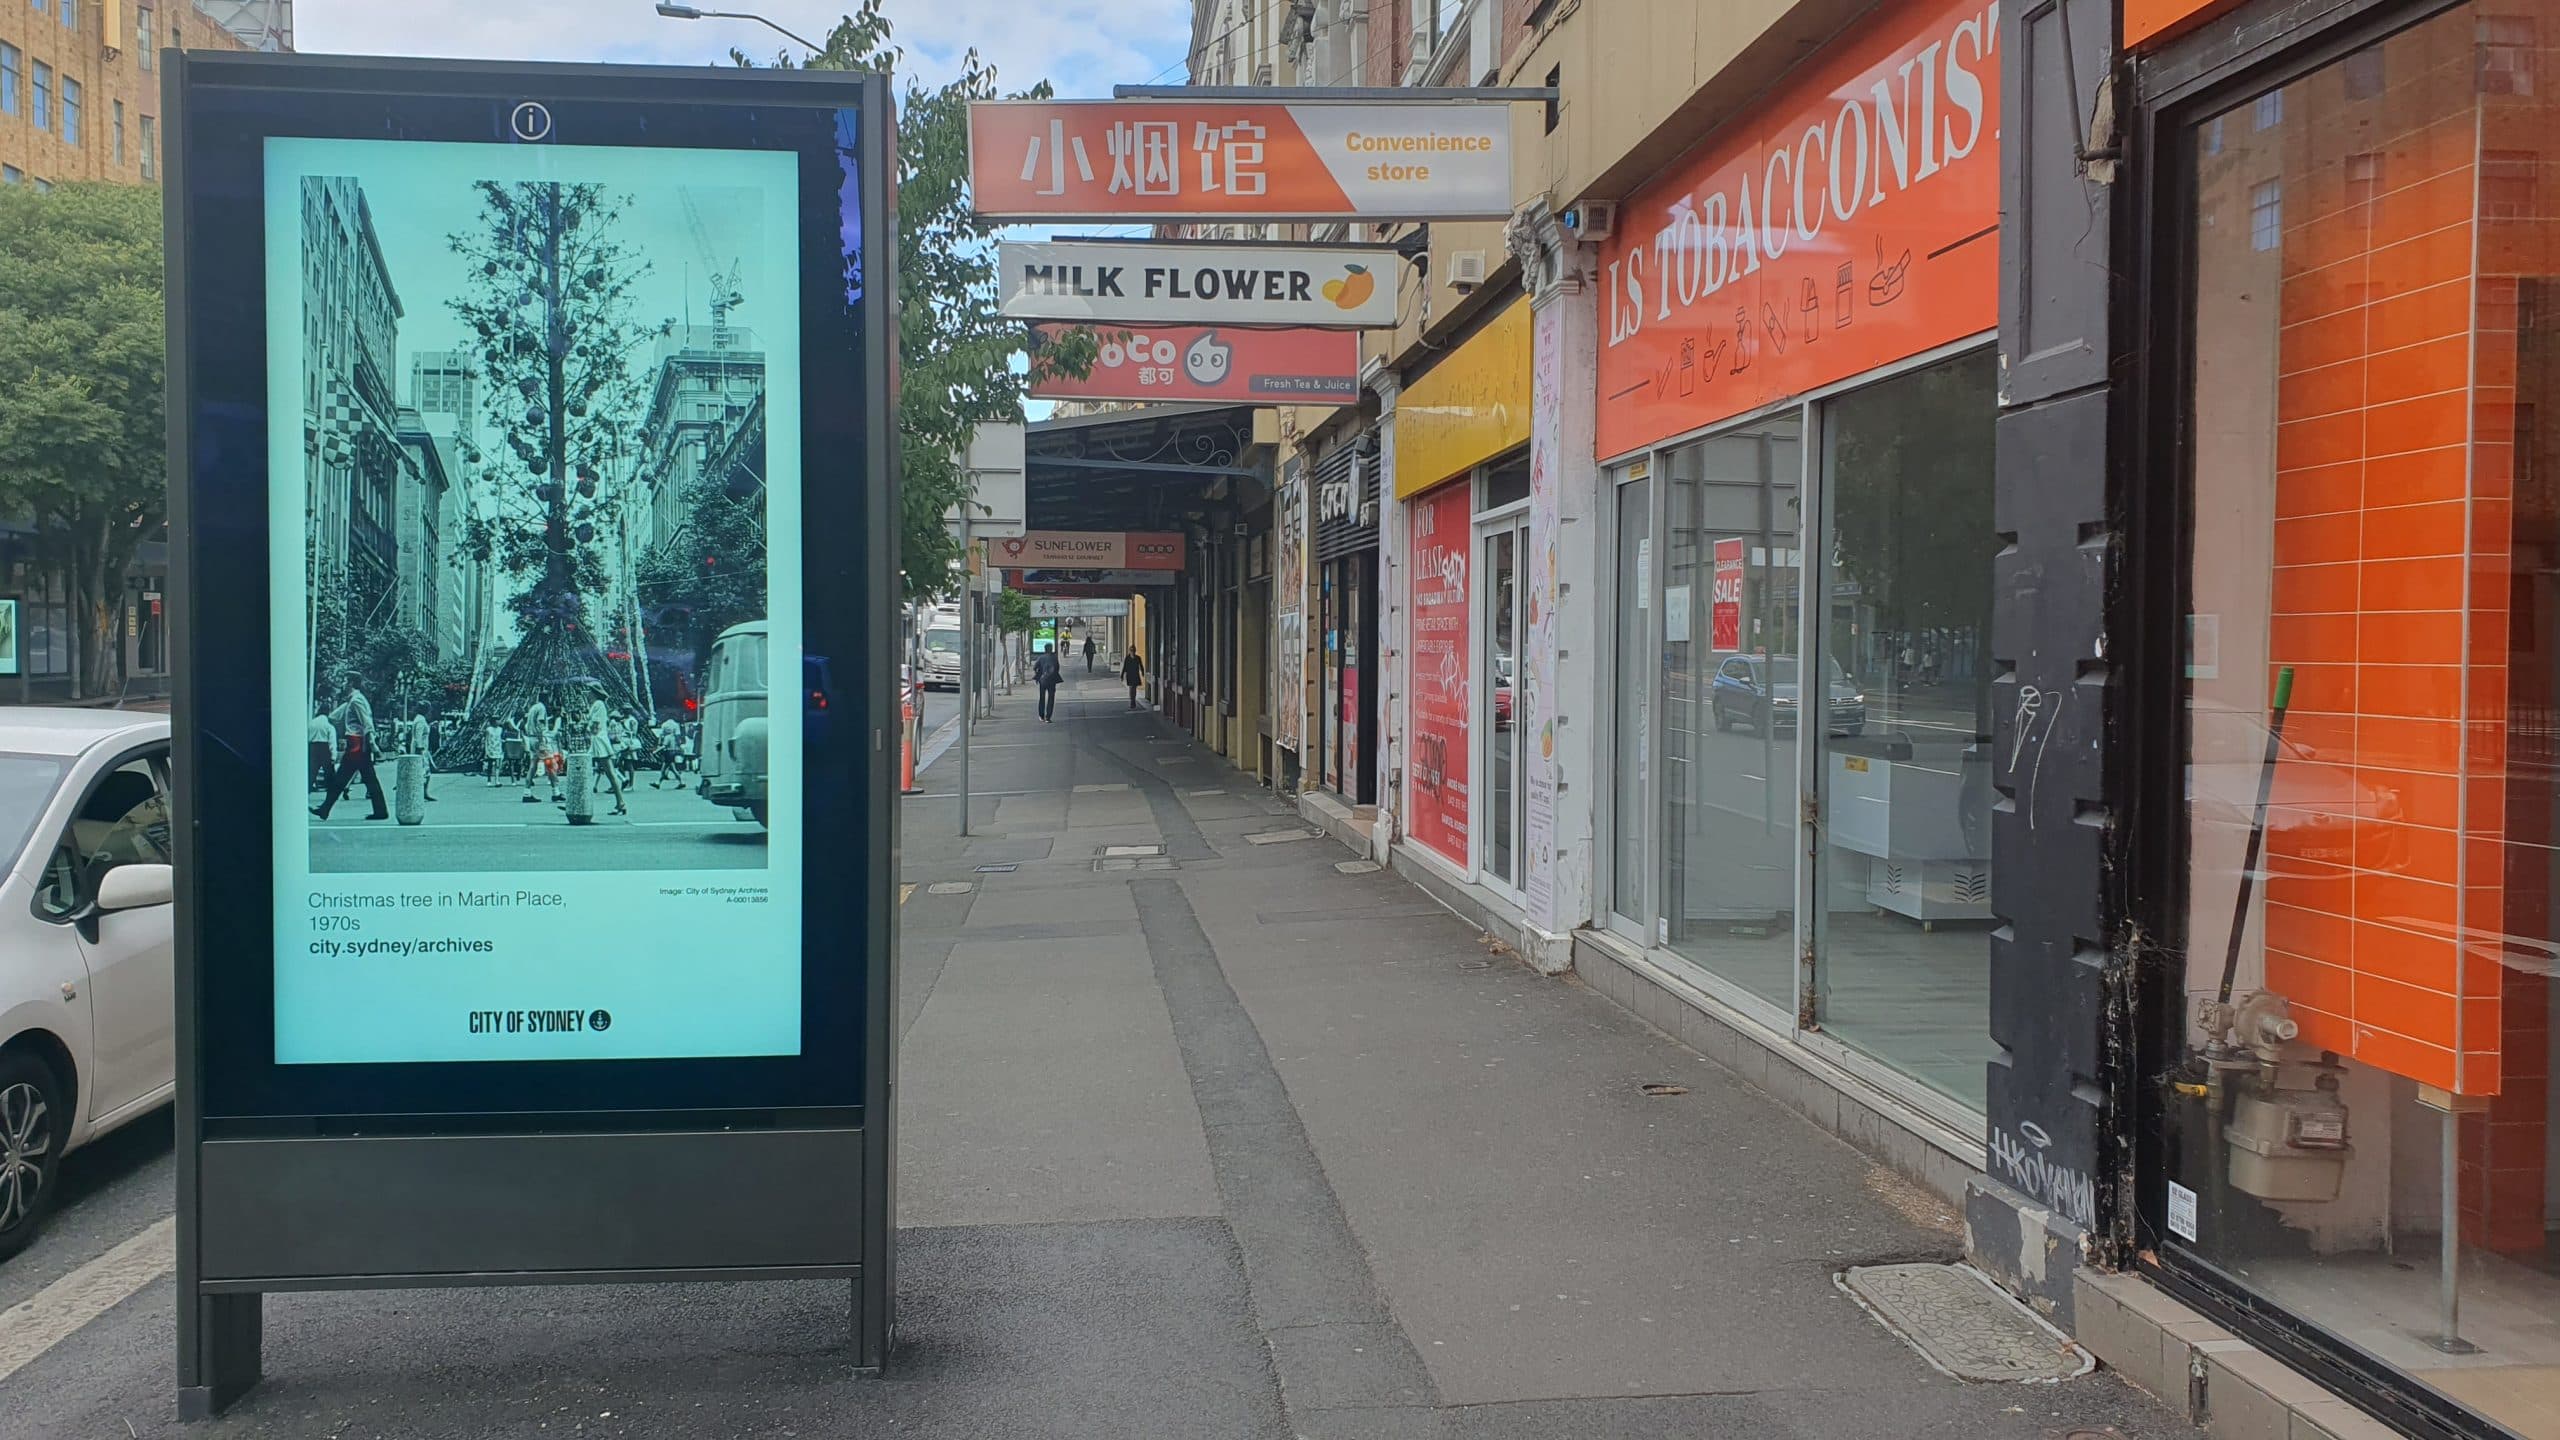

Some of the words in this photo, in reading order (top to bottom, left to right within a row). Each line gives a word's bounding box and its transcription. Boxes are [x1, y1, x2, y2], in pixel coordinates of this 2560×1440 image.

[1346, 132, 1492, 151] Convenience
[1020, 119, 1266, 196] 小烟馆
[1367, 162, 1429, 181] store
[1024, 264, 1125, 297] MILK
[1144, 268, 1312, 301] FLOWER
[1608, 243, 1644, 348] LS
[1138, 367, 1175, 385] 都可
[1264, 378, 1291, 389] Fresh
[1294, 379, 1311, 389] Tea
[1313, 380, 1321, 389] &
[1325, 379, 1351, 390] Juice
[1417, 504, 1434, 538] FOR
[1034, 540, 1113, 552] SUNFLOWER
[1416, 545, 1444, 580] LEASE
[1714, 578, 1740, 603] SALE
[308, 892, 395, 908] Christmas
[400, 893, 433, 907] tree
[438, 892, 452, 907] in
[458, 891, 510, 907] Martin
[516, 890, 567, 908] Place,
[686, 887, 700, 895] City
[710, 887, 737, 895] Sydney
[309, 915, 361, 931] 1970s
[309, 937, 494, 957] city.sydney/archives
[469, 1011, 503, 1033] CITY
[507, 1010, 525, 1033] OF
[527, 1009, 585, 1032] SYDNEY
